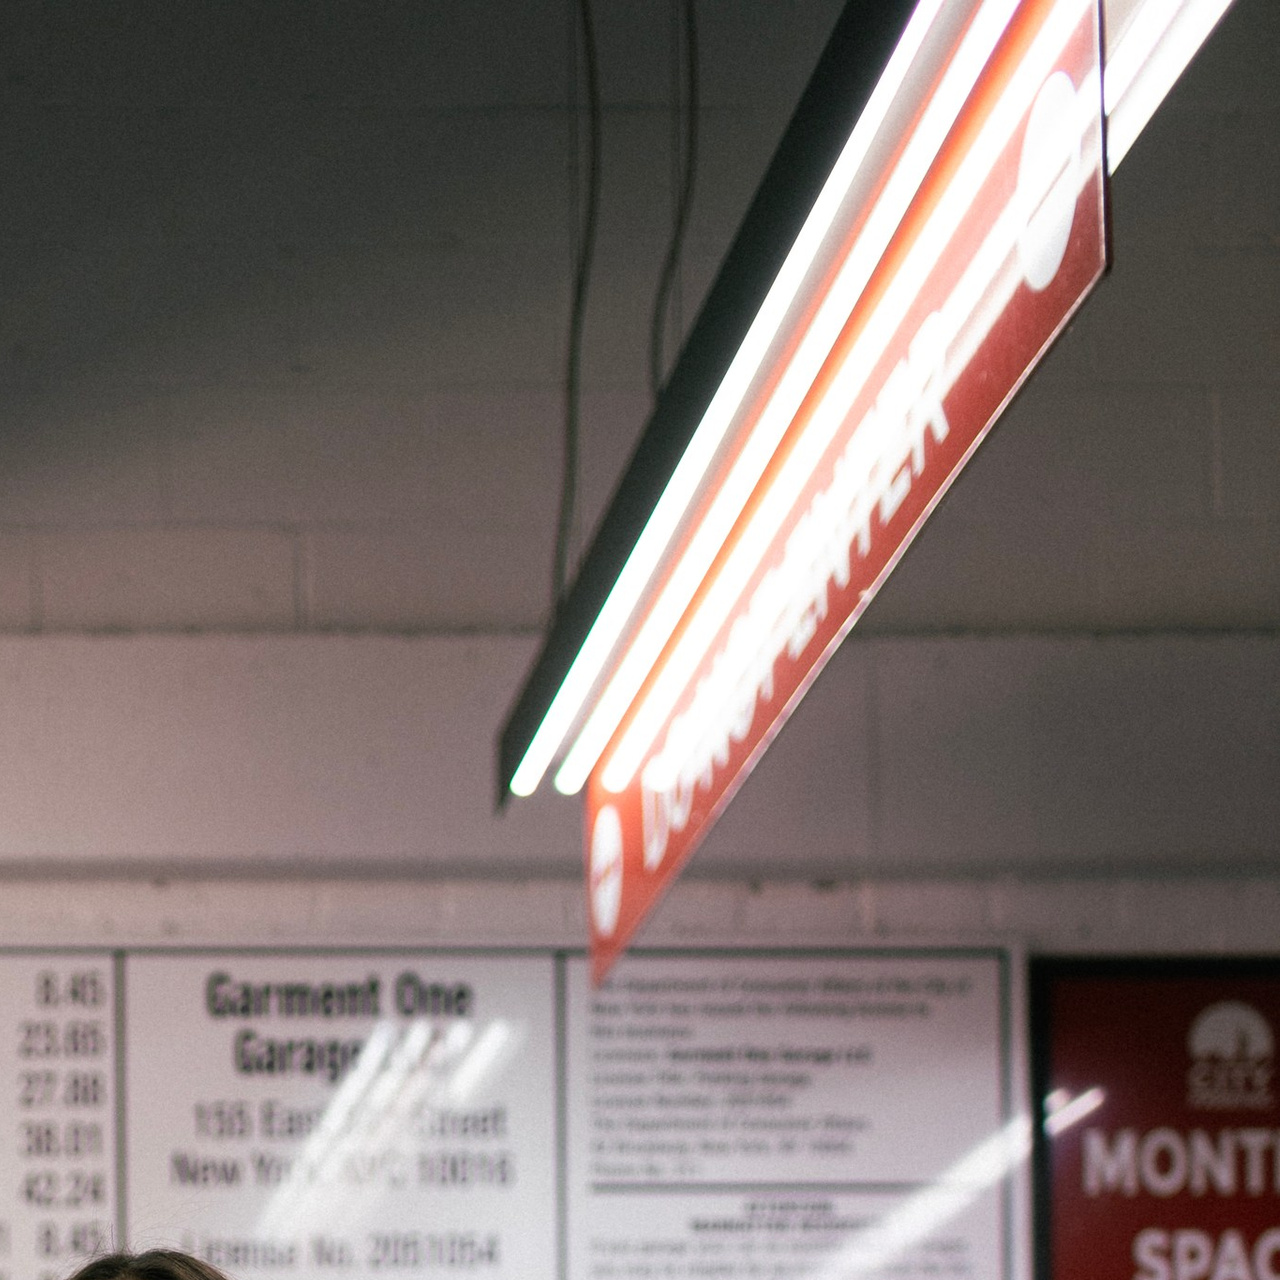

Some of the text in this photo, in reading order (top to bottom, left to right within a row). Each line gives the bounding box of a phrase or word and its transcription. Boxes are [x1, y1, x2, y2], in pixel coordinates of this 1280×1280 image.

[204, 971, 474, 1021] Garment One
[261, 1103, 326, 1142] Eas
[171, 1153, 244, 1190] New
[415, 1153, 514, 1190] 10016
[1084, 1129, 1280, 1196] MONT
